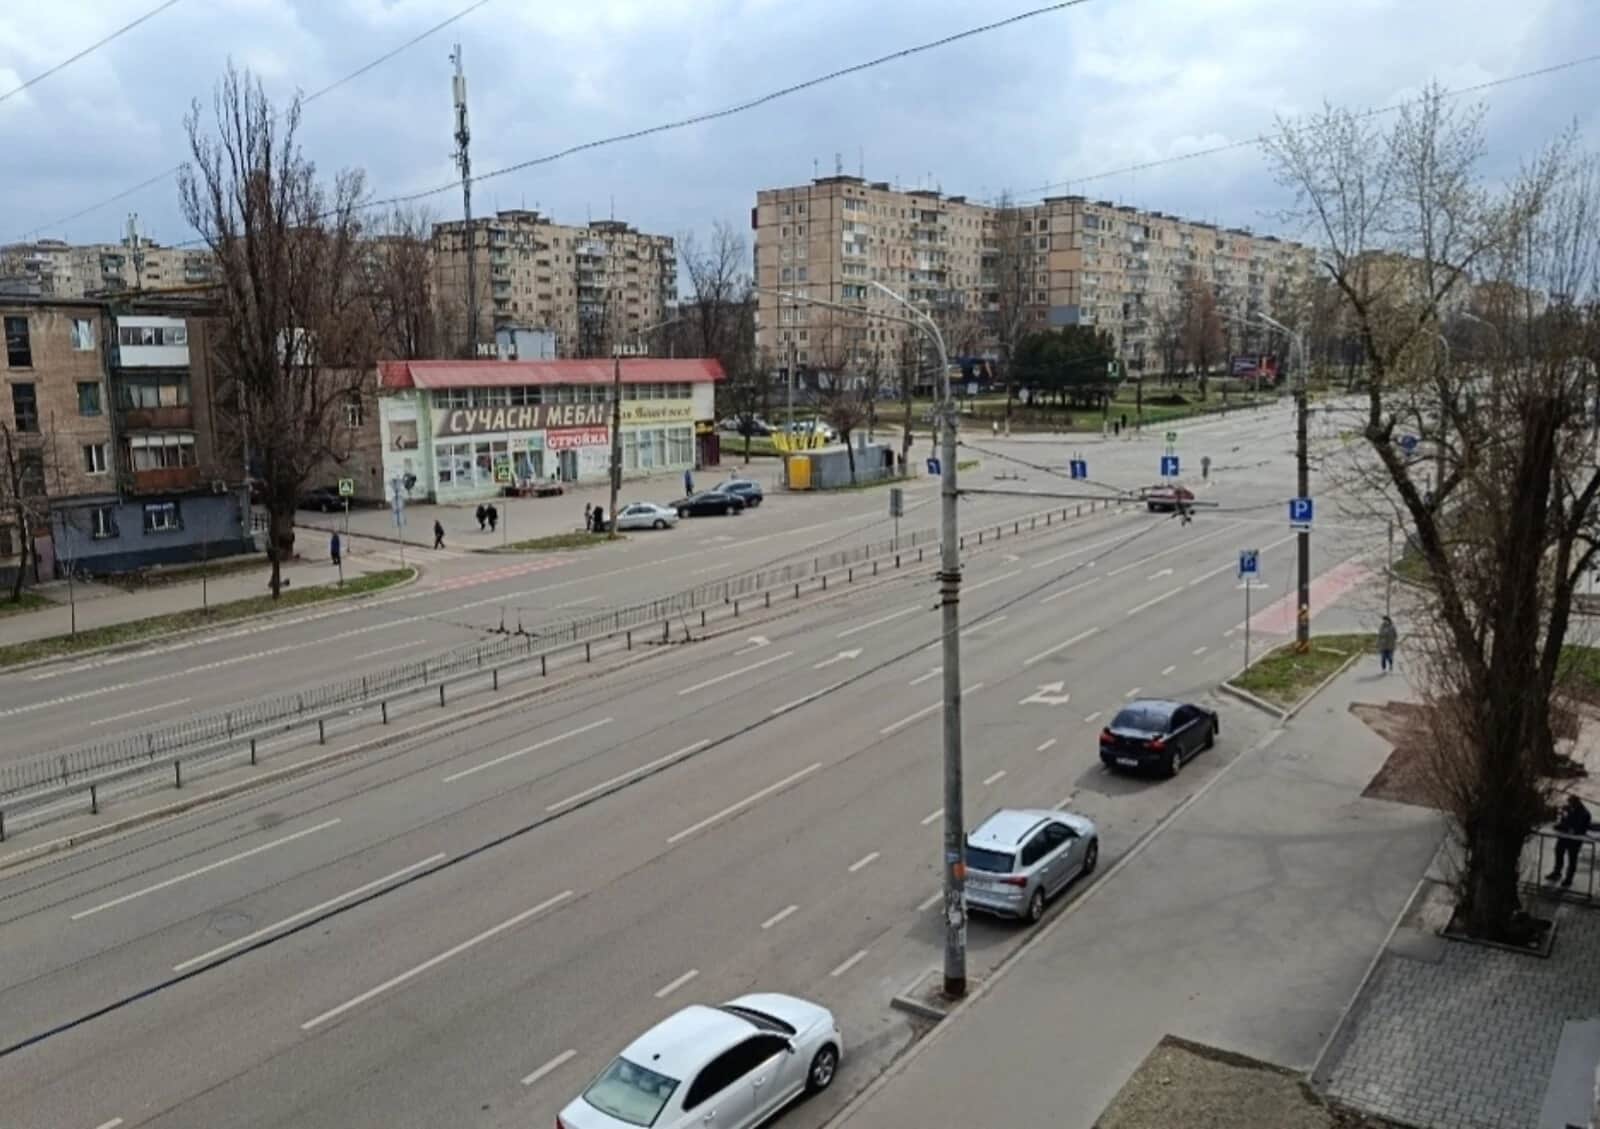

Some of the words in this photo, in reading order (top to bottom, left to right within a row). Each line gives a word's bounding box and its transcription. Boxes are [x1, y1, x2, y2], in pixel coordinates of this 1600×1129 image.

[451, 408, 538, 433] СУЧАСНІ
[546, 404, 603, 427] МЕБЛІ
[1295, 500, 1308, 517] P
